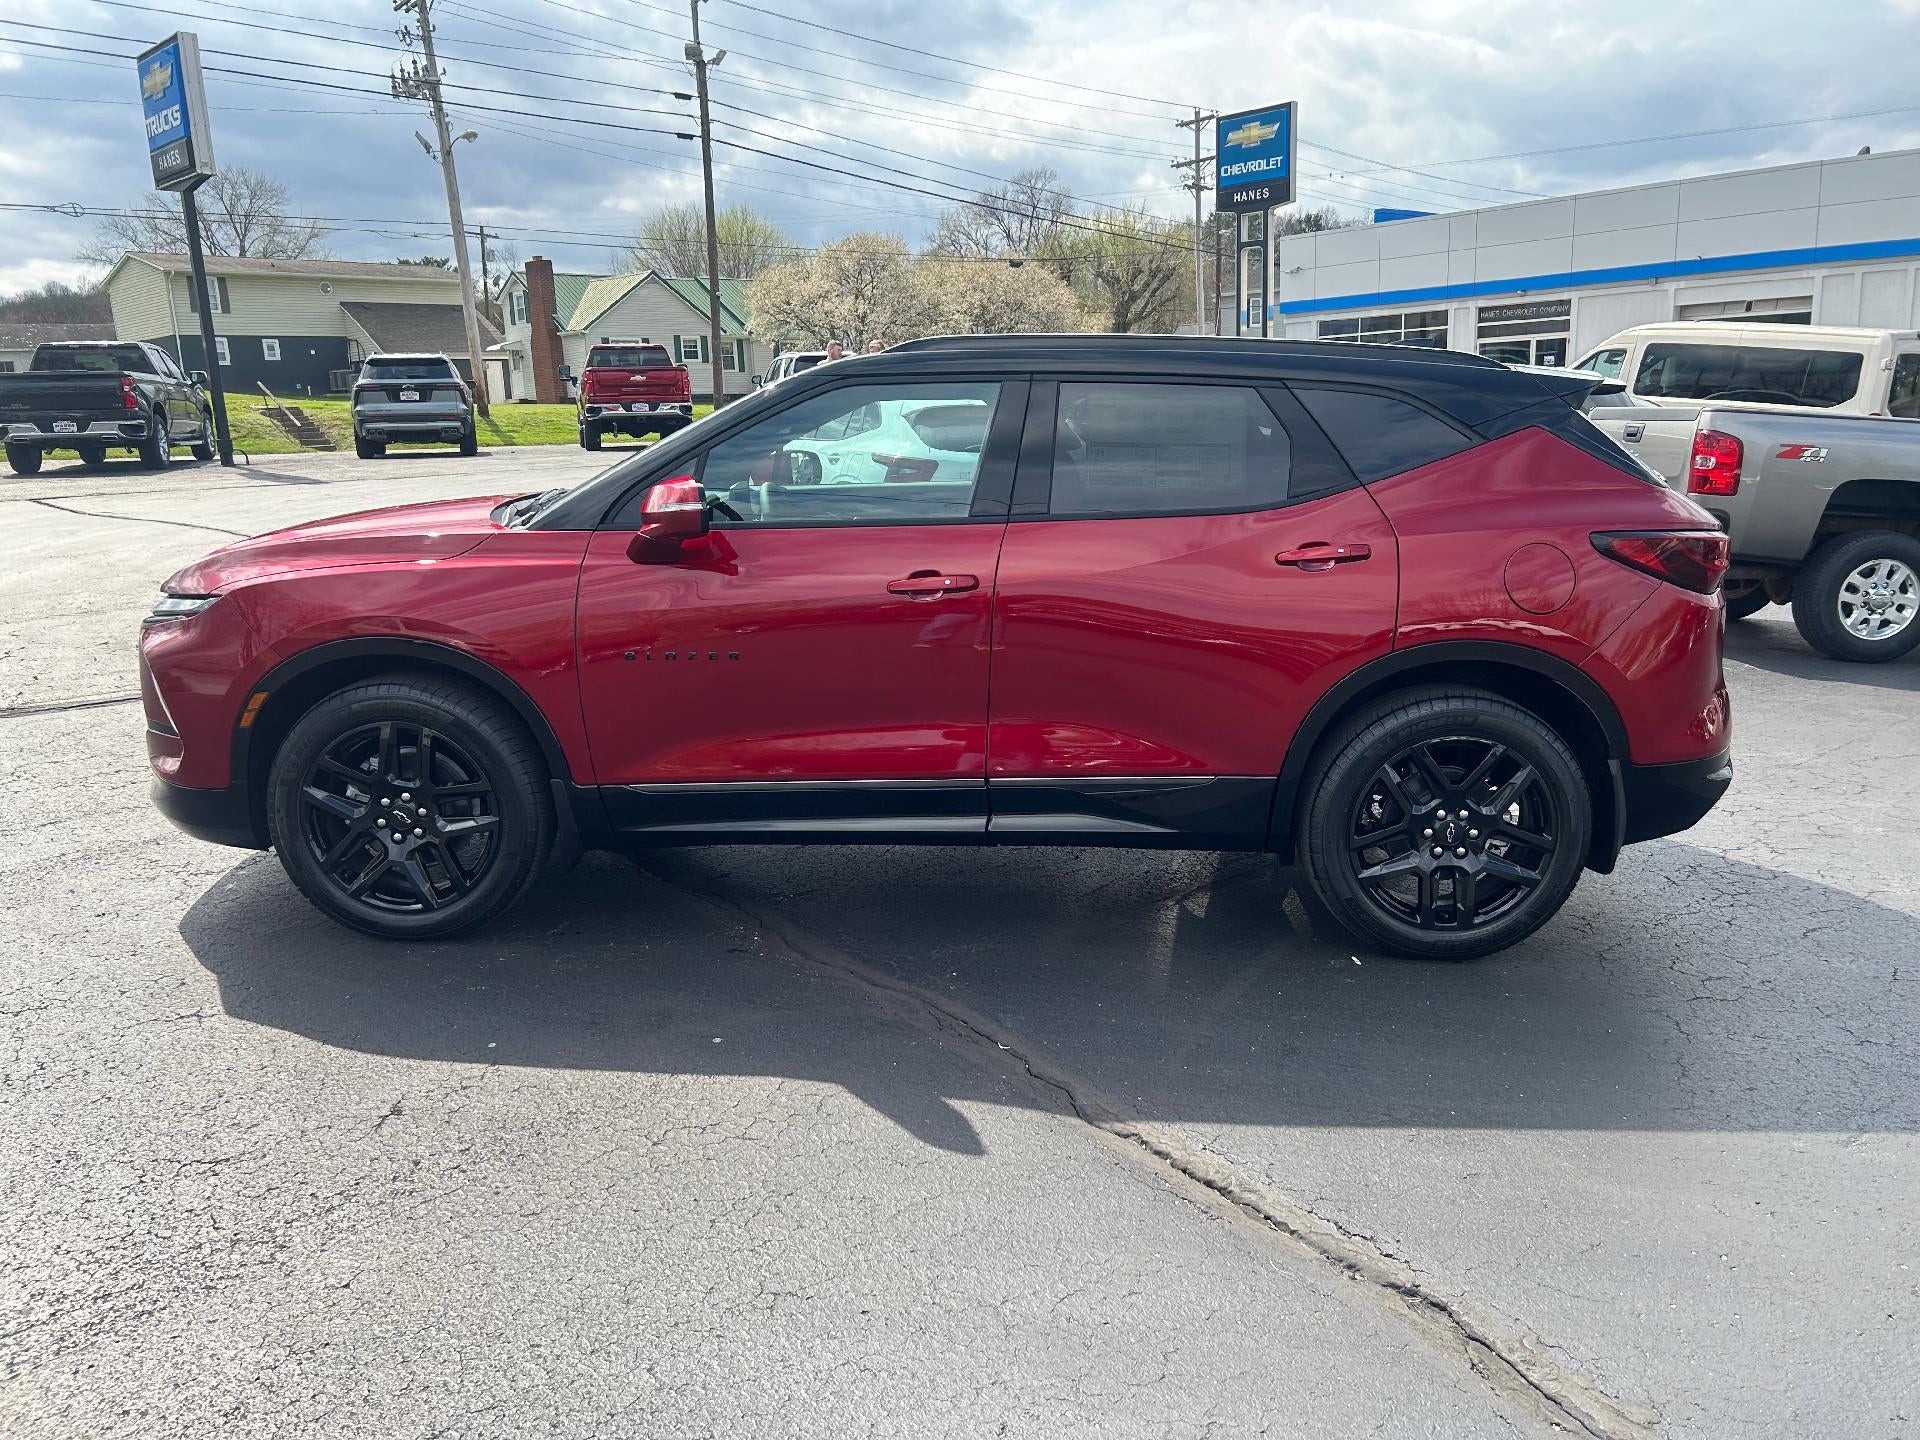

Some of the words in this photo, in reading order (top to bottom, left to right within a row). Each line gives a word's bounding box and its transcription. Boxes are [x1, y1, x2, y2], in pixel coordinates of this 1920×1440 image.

[145, 104, 181, 138] TRUCKS
[1220, 156, 1283, 177] CHEVROLET
[1233, 188, 1270, 203] HANES
[1480, 310, 1500, 319] HANES
[1502, 307, 1537, 318] CHEVROLET
[1539, 304, 1569, 314] COMPANY
[624, 651, 741, 661] BLAZER
